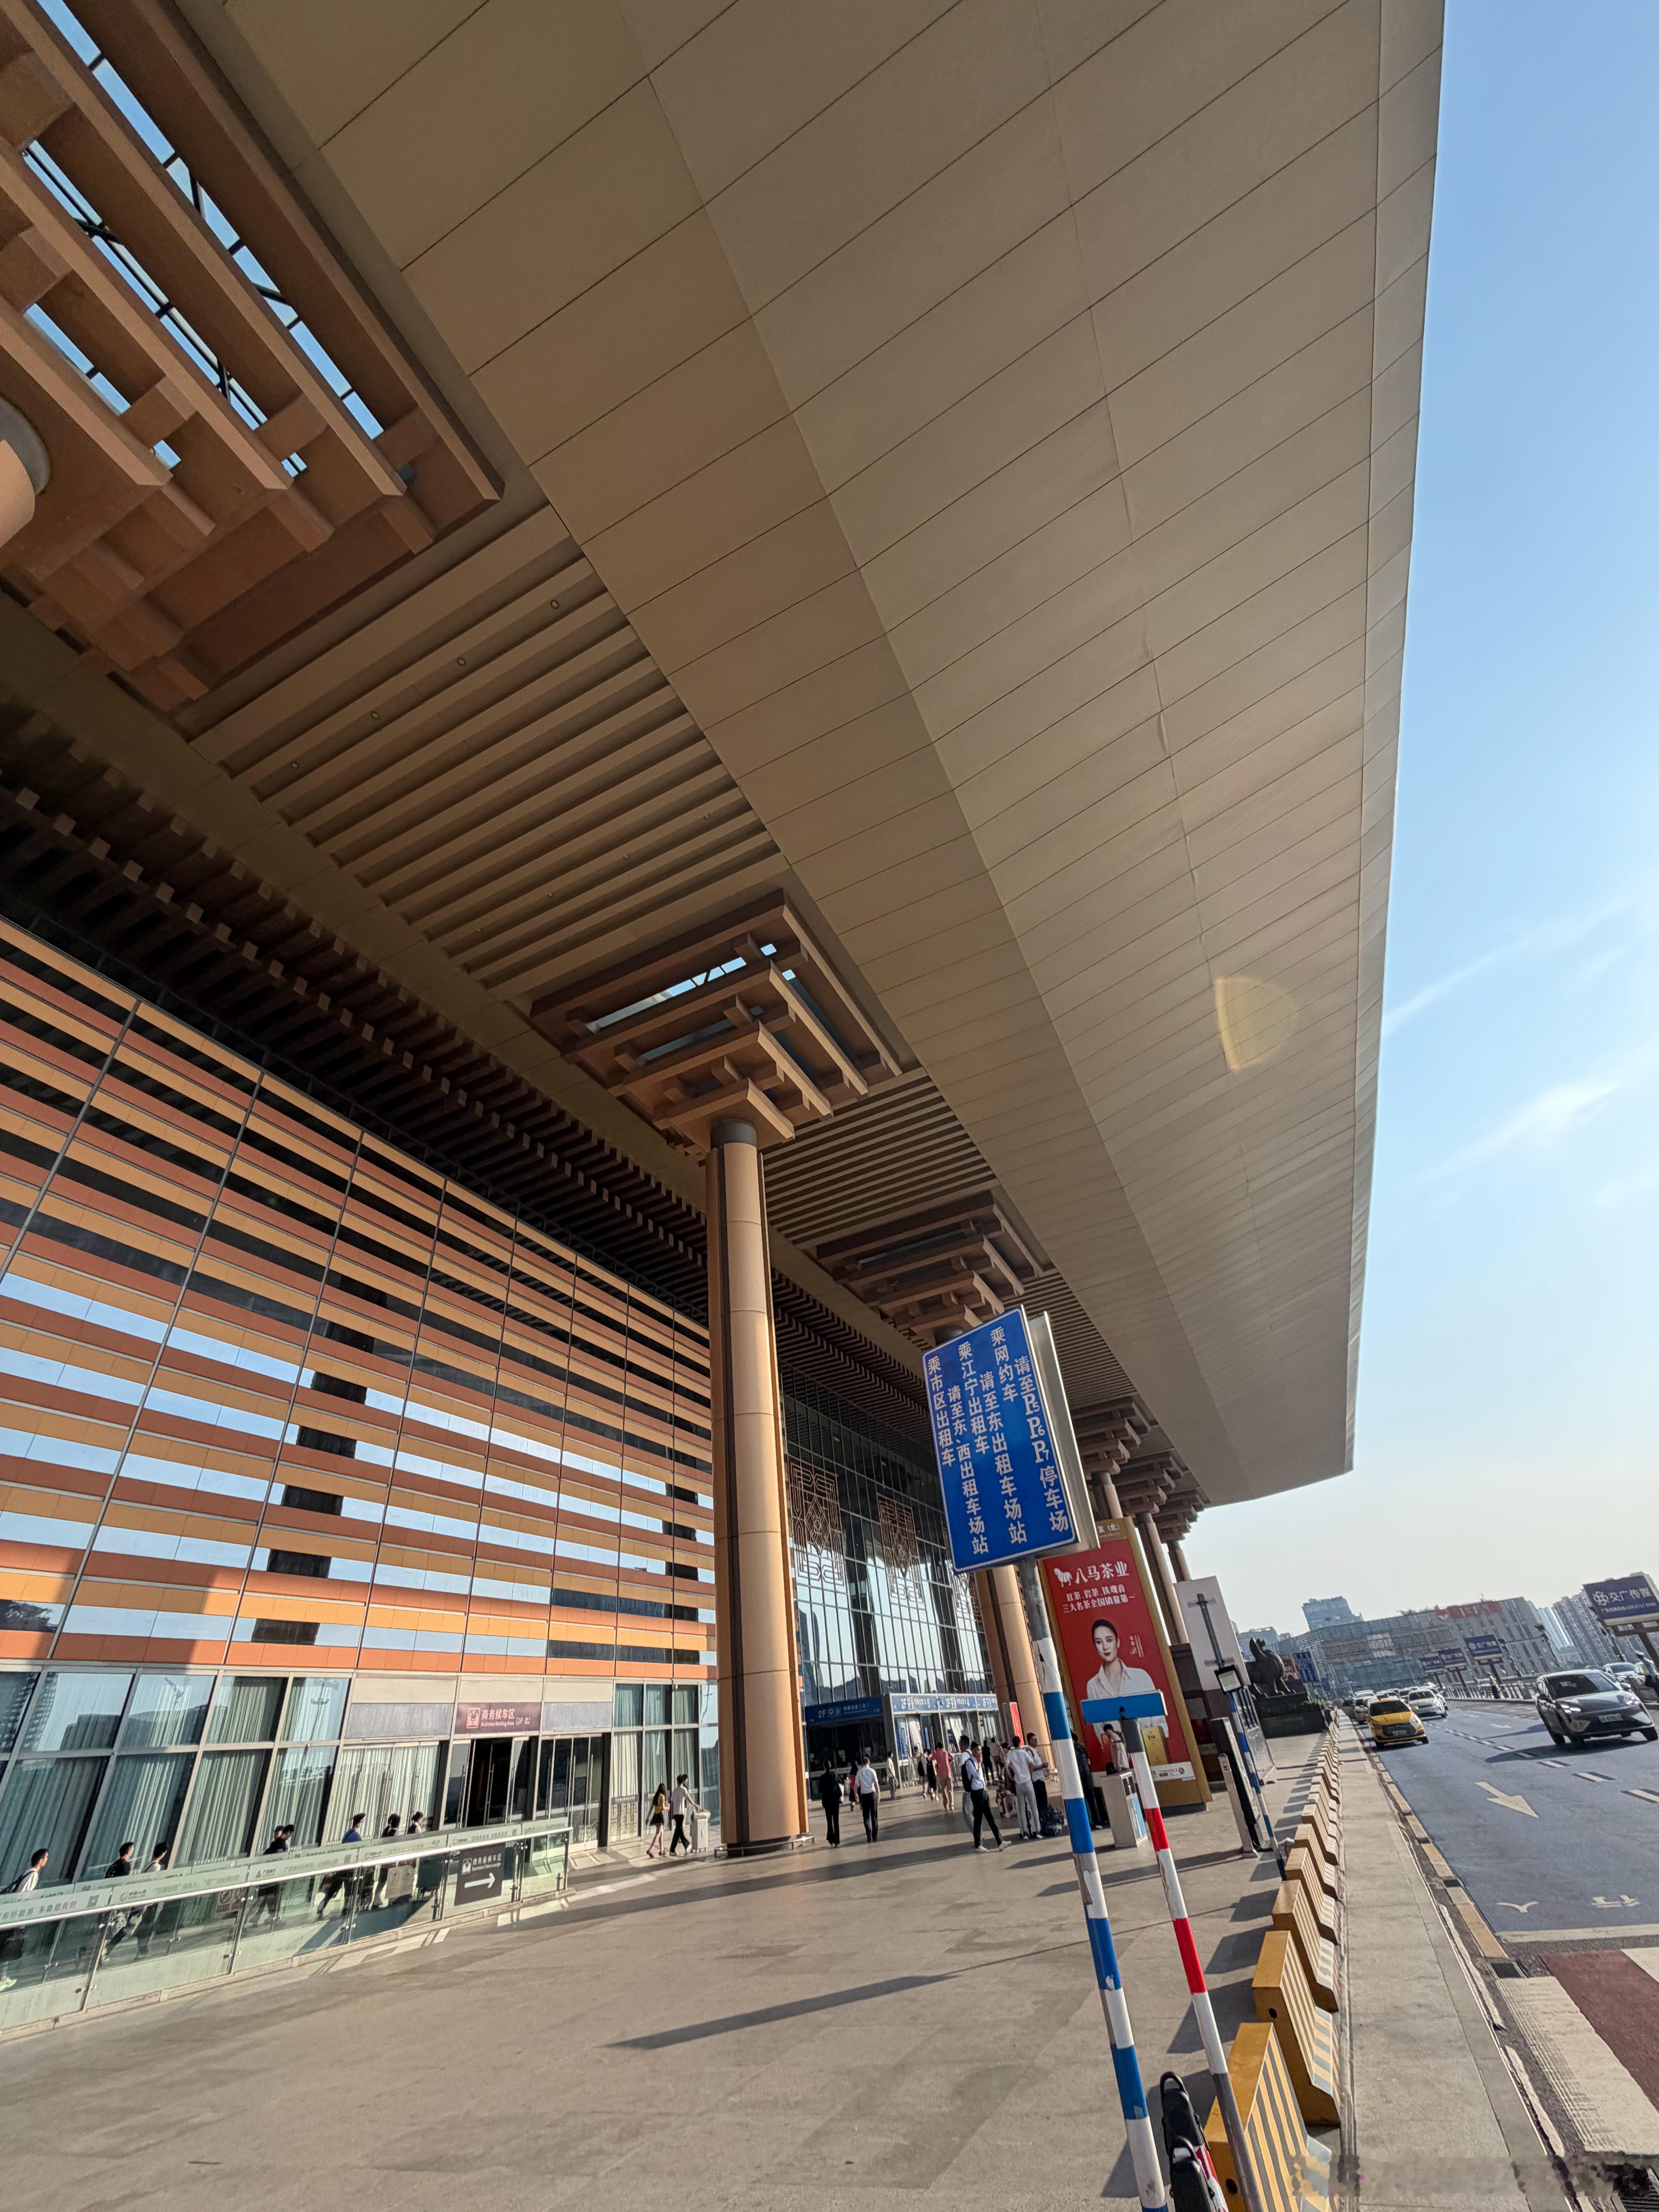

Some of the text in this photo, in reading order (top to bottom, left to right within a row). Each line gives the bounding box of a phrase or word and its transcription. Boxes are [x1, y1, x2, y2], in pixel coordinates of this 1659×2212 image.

[958, 1341, 990, 1455] 乘江宁出租车
[991, 1326, 1018, 1403] 乘网约车
[927, 1355, 956, 1467] 乘市区出租车
[947, 1385, 989, 1555] 请至东、西出租车场站
[979, 1371, 1027, 1544] 请至东出租车场站
[1075, 1561, 1130, 1584] 八马茶业
[1608, 1587, 1652, 1602] 交广传媒
[482, 1709, 515, 1721] 商务候车区
[818, 1709, 827, 1718] 2F
